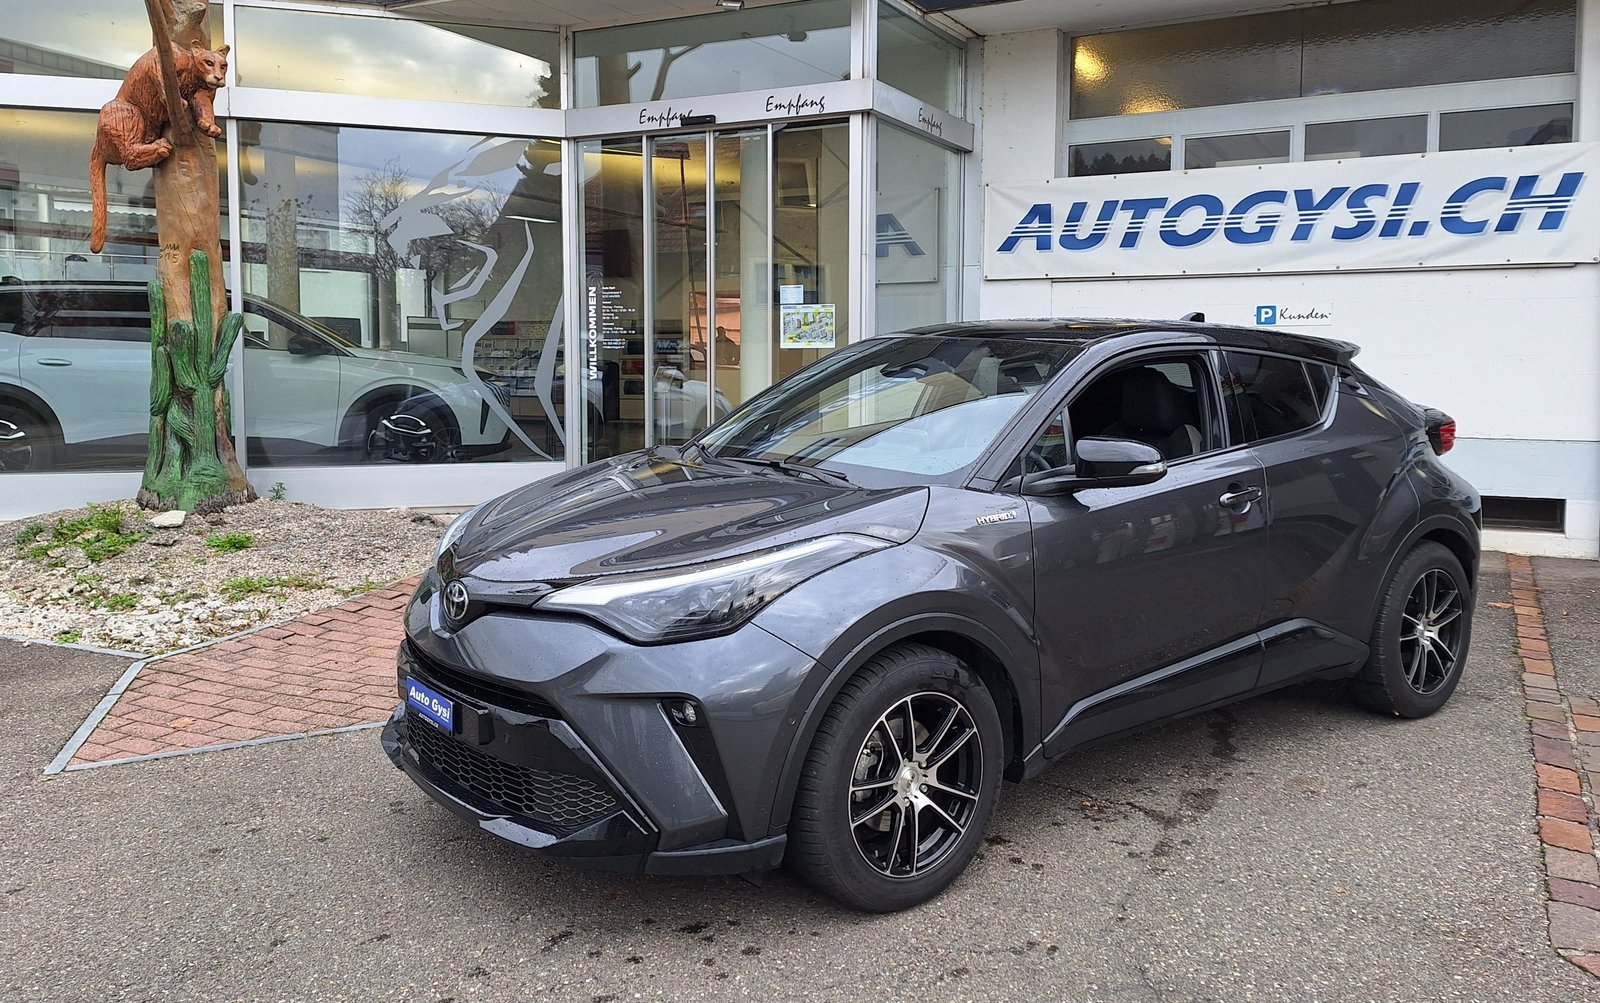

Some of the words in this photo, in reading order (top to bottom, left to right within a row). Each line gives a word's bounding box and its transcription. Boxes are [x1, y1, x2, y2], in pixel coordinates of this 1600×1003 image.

[765, 93, 826, 115] Empfang
[918, 107, 943, 137] Empfang
[997, 171, 1586, 253] AUTOGYSI.CH
[1260, 307, 1274, 323] P
[1279, 307, 1329, 320] Kunden
[588, 286, 598, 380] WILLKOMMEN
[976, 511, 1011, 525] HYBRID
[410, 686, 430, 706] Auto
[431, 698, 450, 720] Gysi
